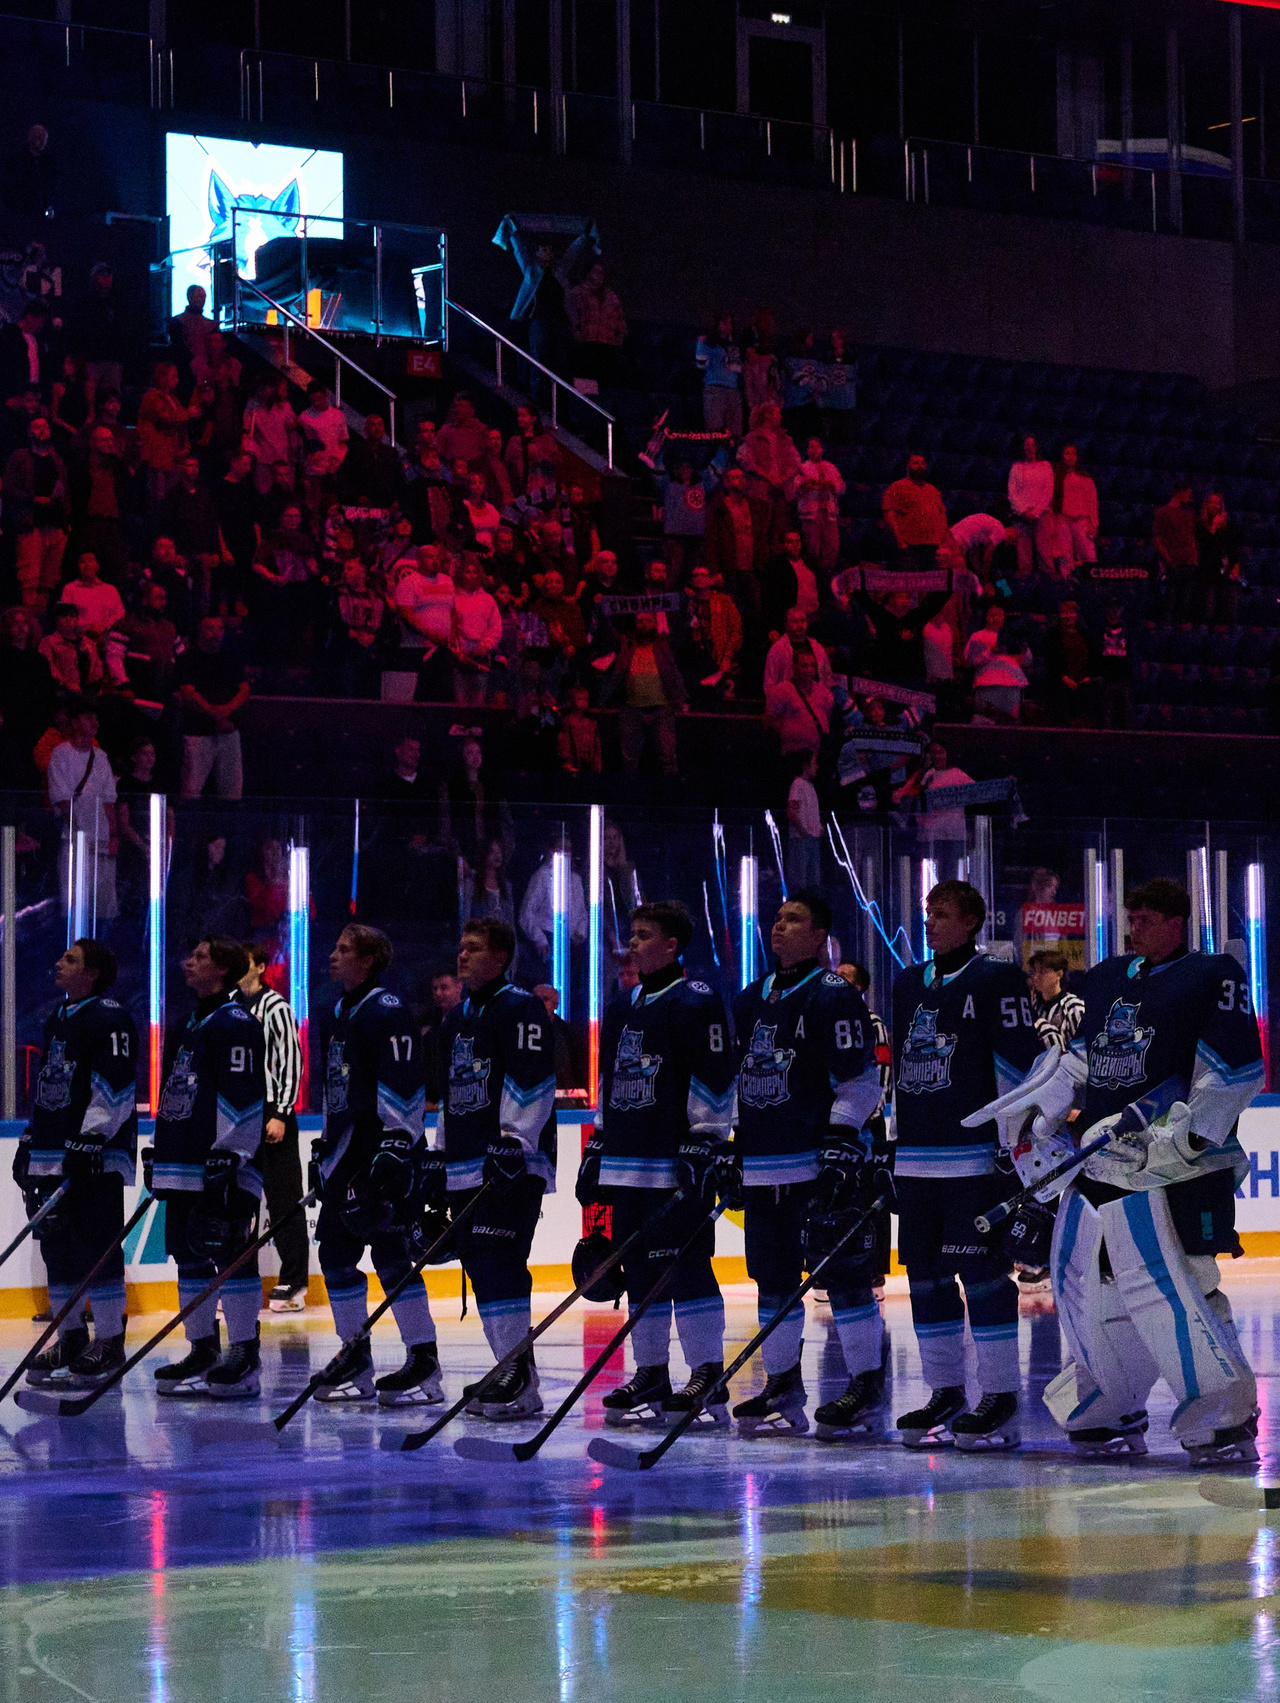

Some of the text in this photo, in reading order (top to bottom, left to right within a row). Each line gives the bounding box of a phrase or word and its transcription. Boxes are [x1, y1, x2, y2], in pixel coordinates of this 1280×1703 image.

[412, 355, 435, 372] E4
[1090, 567, 1149, 579] СИБИРЬ
[609, 597, 671, 612] СИБИРЬ
[1024, 910, 1085, 927] FONBET
[962, 994, 976, 1019] A
[1217, 979, 1250, 1014] 33
[1000, 996, 1033, 1028] 56
[517, 1022, 542, 1051] 12
[708, 1023, 724, 1052] 8
[795, 1015, 806, 1039] A
[834, 1019, 865, 1050] 83
[110, 1031, 130, 1058] 13
[389, 1035, 413, 1061] 17
[64, 1139, 103, 1153] AUER
[648, 1247, 680, 1259] CCM
